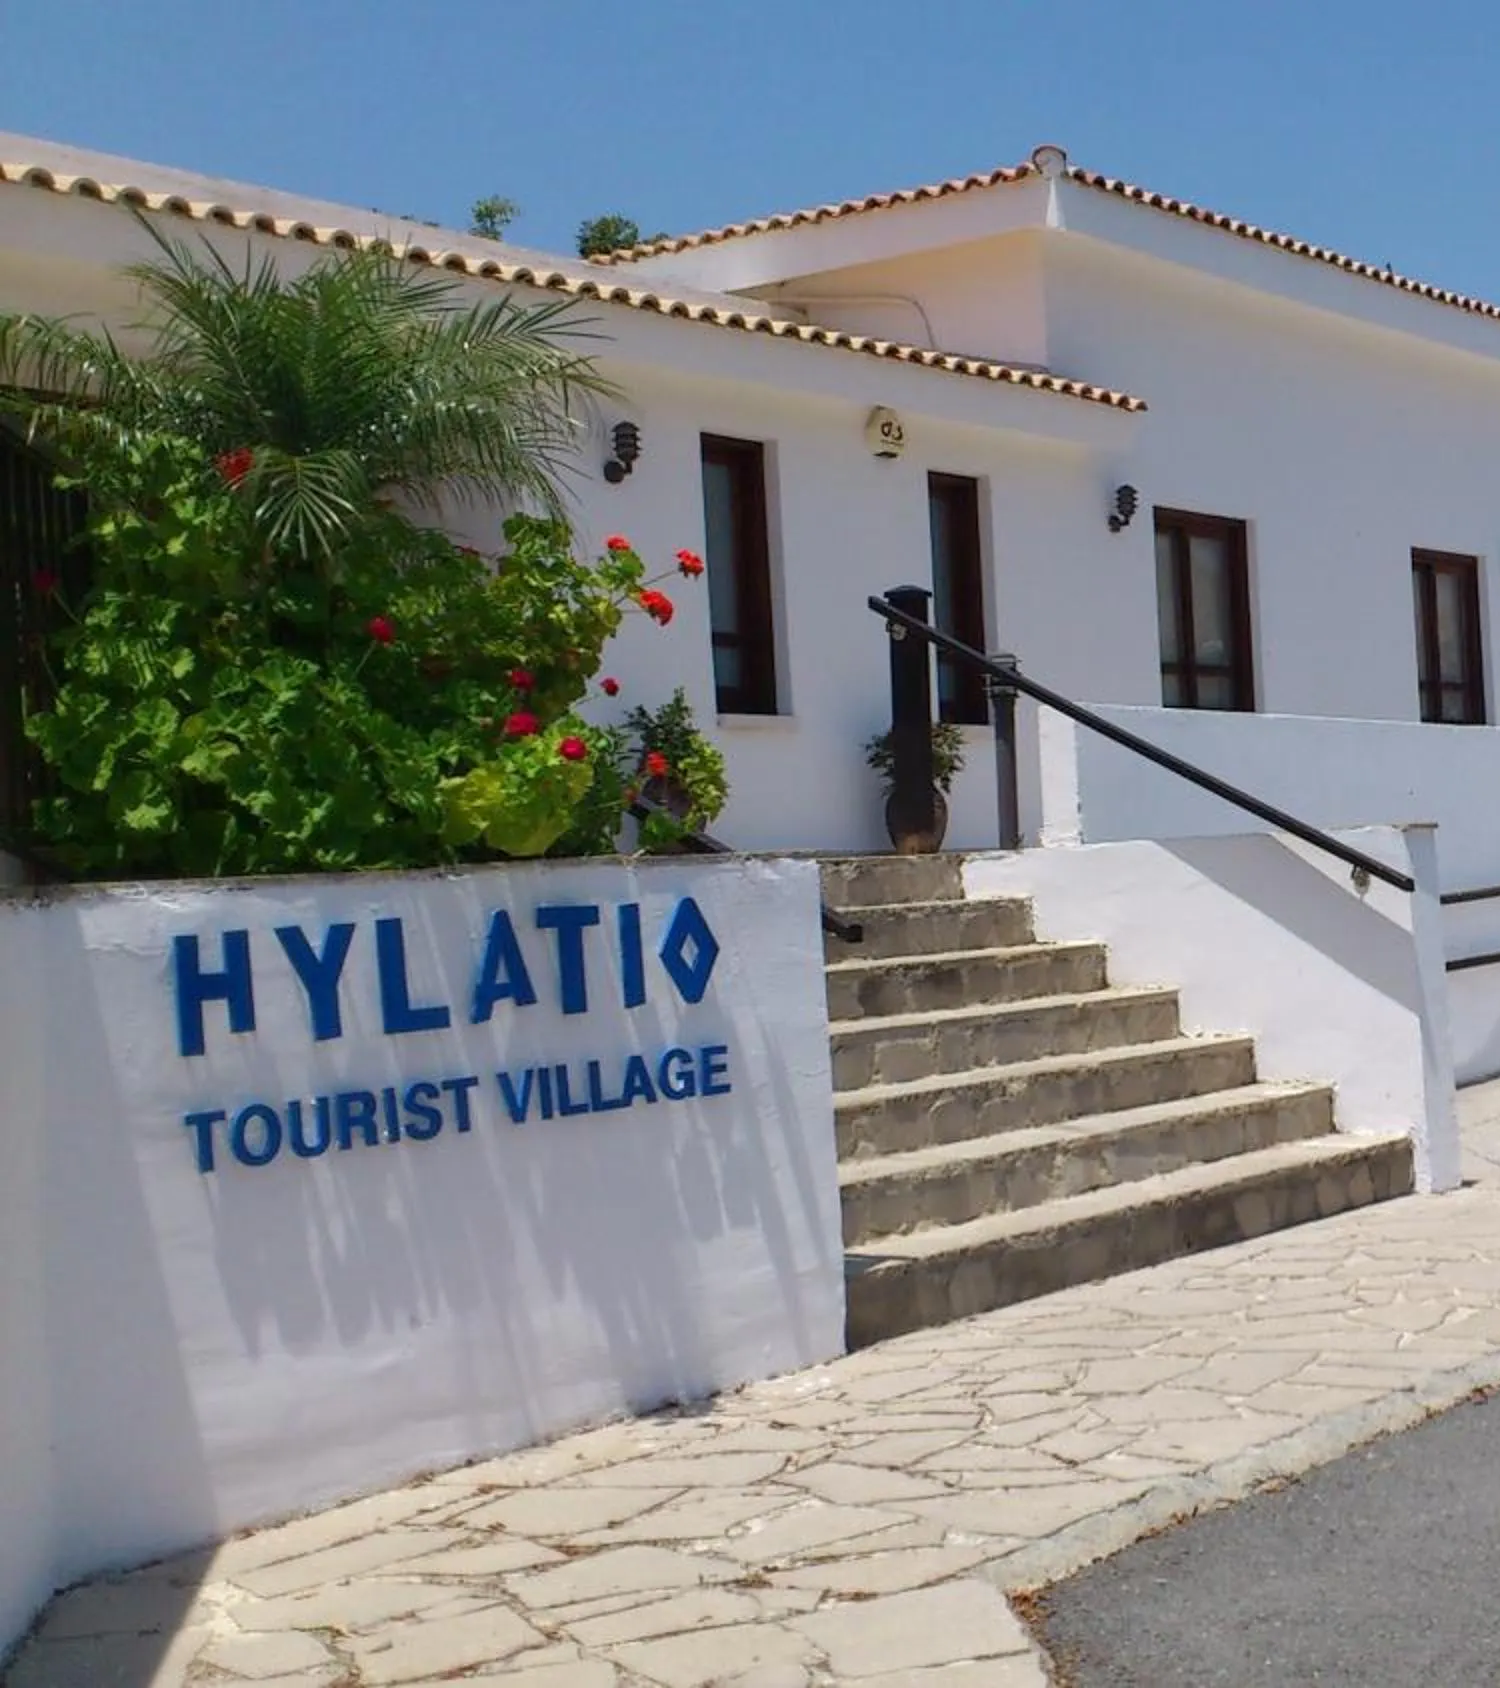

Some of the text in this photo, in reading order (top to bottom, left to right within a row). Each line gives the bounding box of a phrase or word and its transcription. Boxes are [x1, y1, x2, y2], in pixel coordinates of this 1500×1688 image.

[173, 896, 720, 1056] HYLATIO
[184, 1045, 733, 1173] TOURIST VILLAGE
